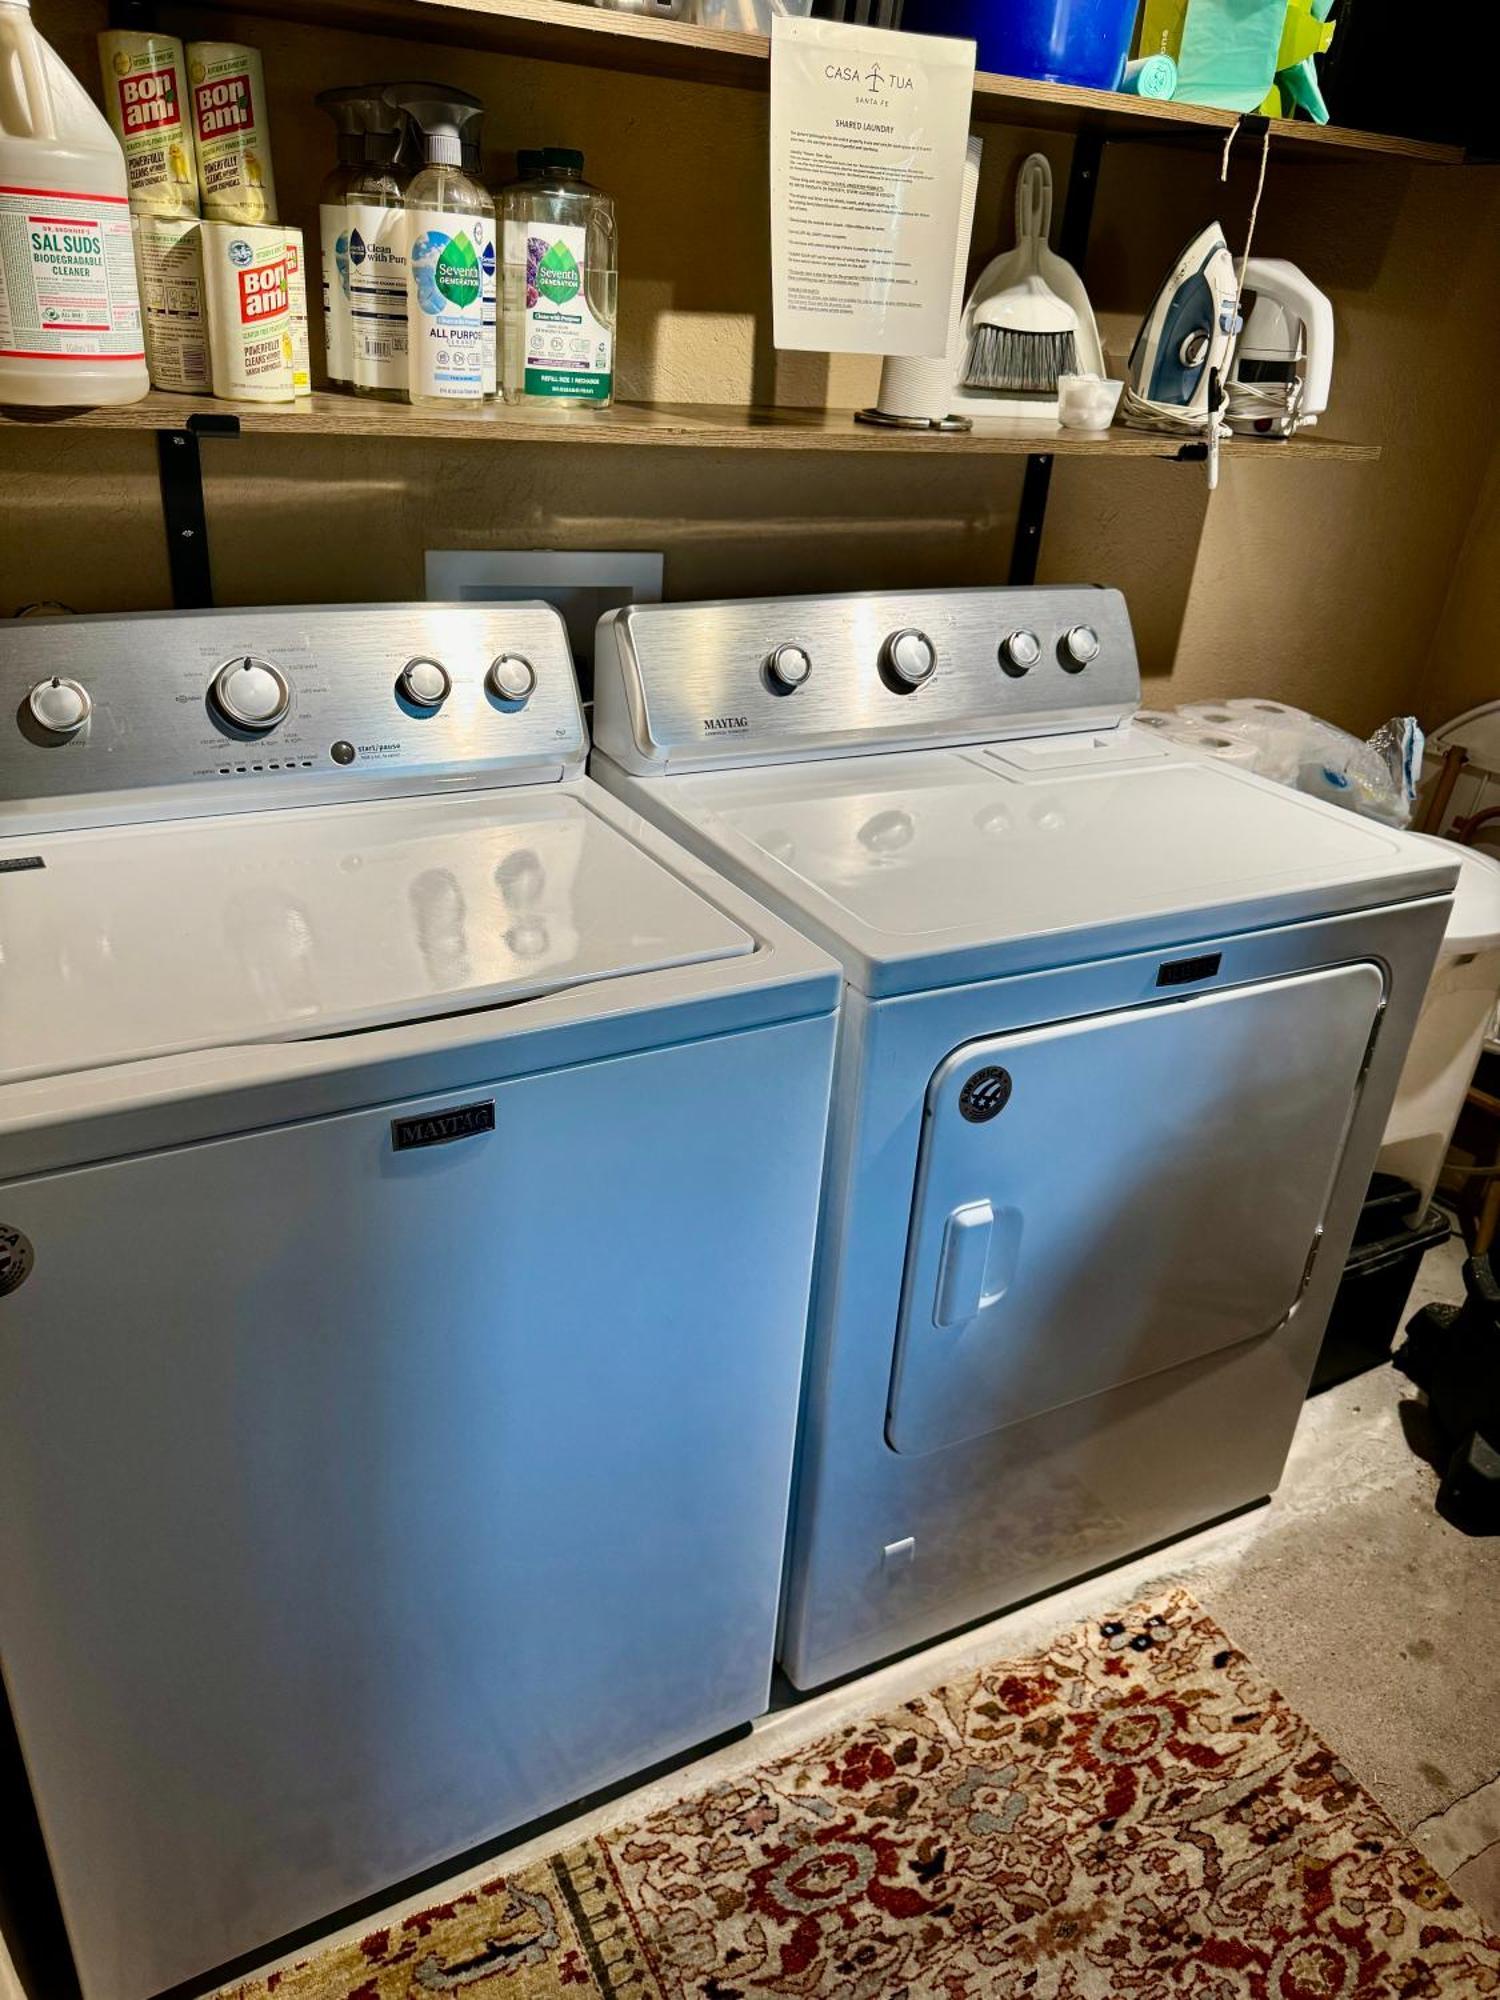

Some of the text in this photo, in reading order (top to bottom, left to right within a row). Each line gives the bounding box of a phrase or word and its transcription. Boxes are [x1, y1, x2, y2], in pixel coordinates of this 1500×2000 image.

[825, 65, 914, 91] CASA TUA
[124, 74, 172, 104] Bon
[199, 81, 245, 111] Bon
[855, 96, 878, 105] SANTA
[127, 99, 174, 126] ami
[202, 106, 247, 132] ami
[835, 119, 895, 134] SHARED LAUNDRY
[32, 232, 101, 255] SAL SUDS
[367, 244, 392, 254] Clean
[34, 253, 104, 266] BIODEGRADABLE
[367, 253, 388, 263] with
[53, 266, 90, 277] CLEANER
[439, 263, 479, 279] Seventh
[540, 267, 578, 281] Seventh
[245, 266, 287, 295] Bon
[246, 288, 287, 316] ami
[430, 328, 449, 339] ALL
[245, 355, 266, 368] CLEANS
[704, 716, 749, 730] MAYTAG
[358, 743, 401, 753] start/pause
[402, 1109, 489, 1143] MAYTAG
